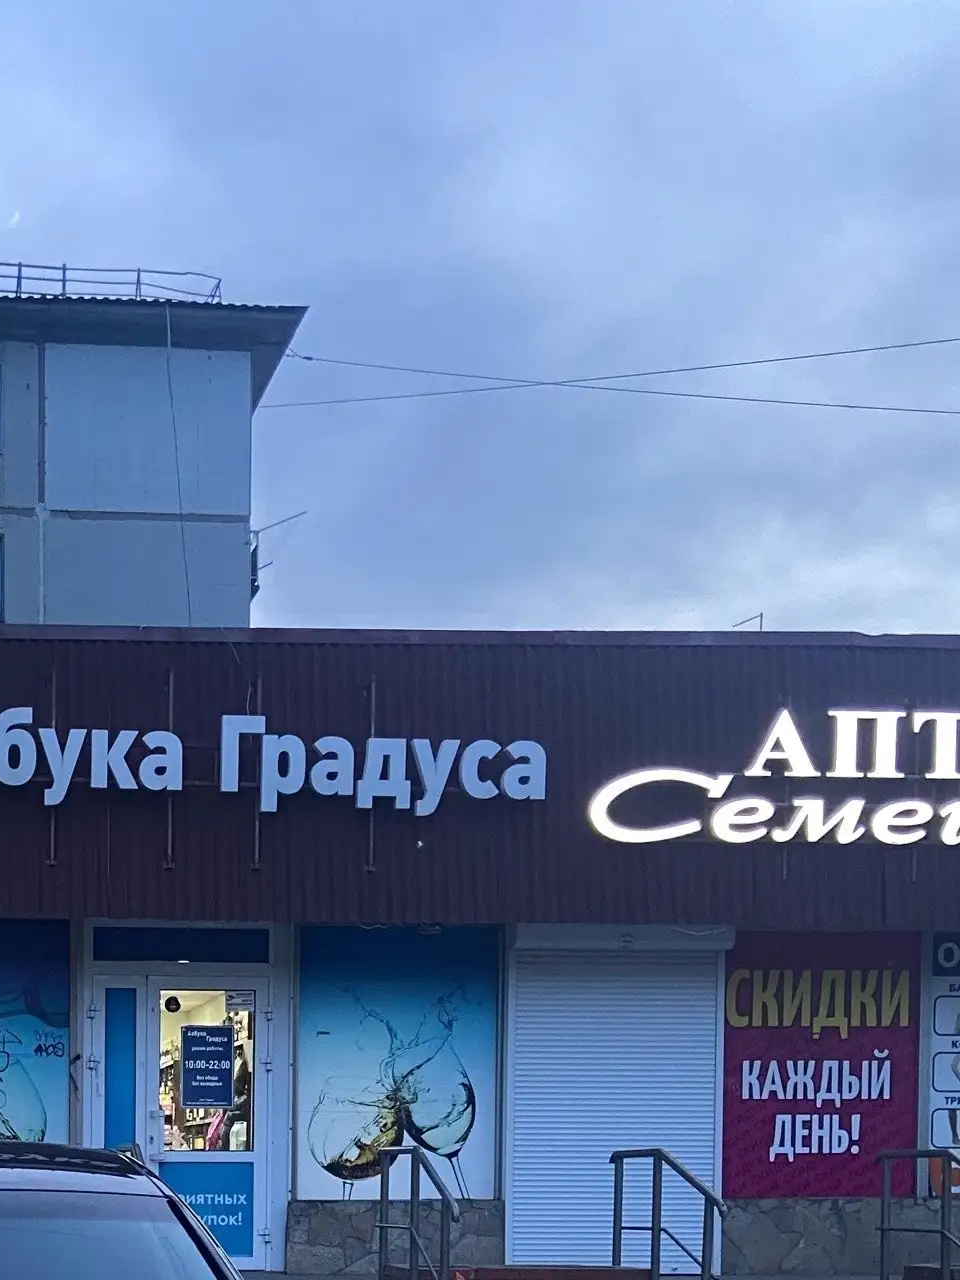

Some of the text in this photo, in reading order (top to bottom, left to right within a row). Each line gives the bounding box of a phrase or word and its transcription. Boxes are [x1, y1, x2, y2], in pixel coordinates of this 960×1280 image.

[219, 714, 547, 817] Градуса
[744, 708, 960, 780] АПТ
[726, 968, 910, 1040] СКИДКИ
[185, 1060, 231, 1069] 10:00-22:00
[741, 1048, 891, 1108] КАЖДЫЙ
[769, 1113, 862, 1162] ДЕНЬ!
